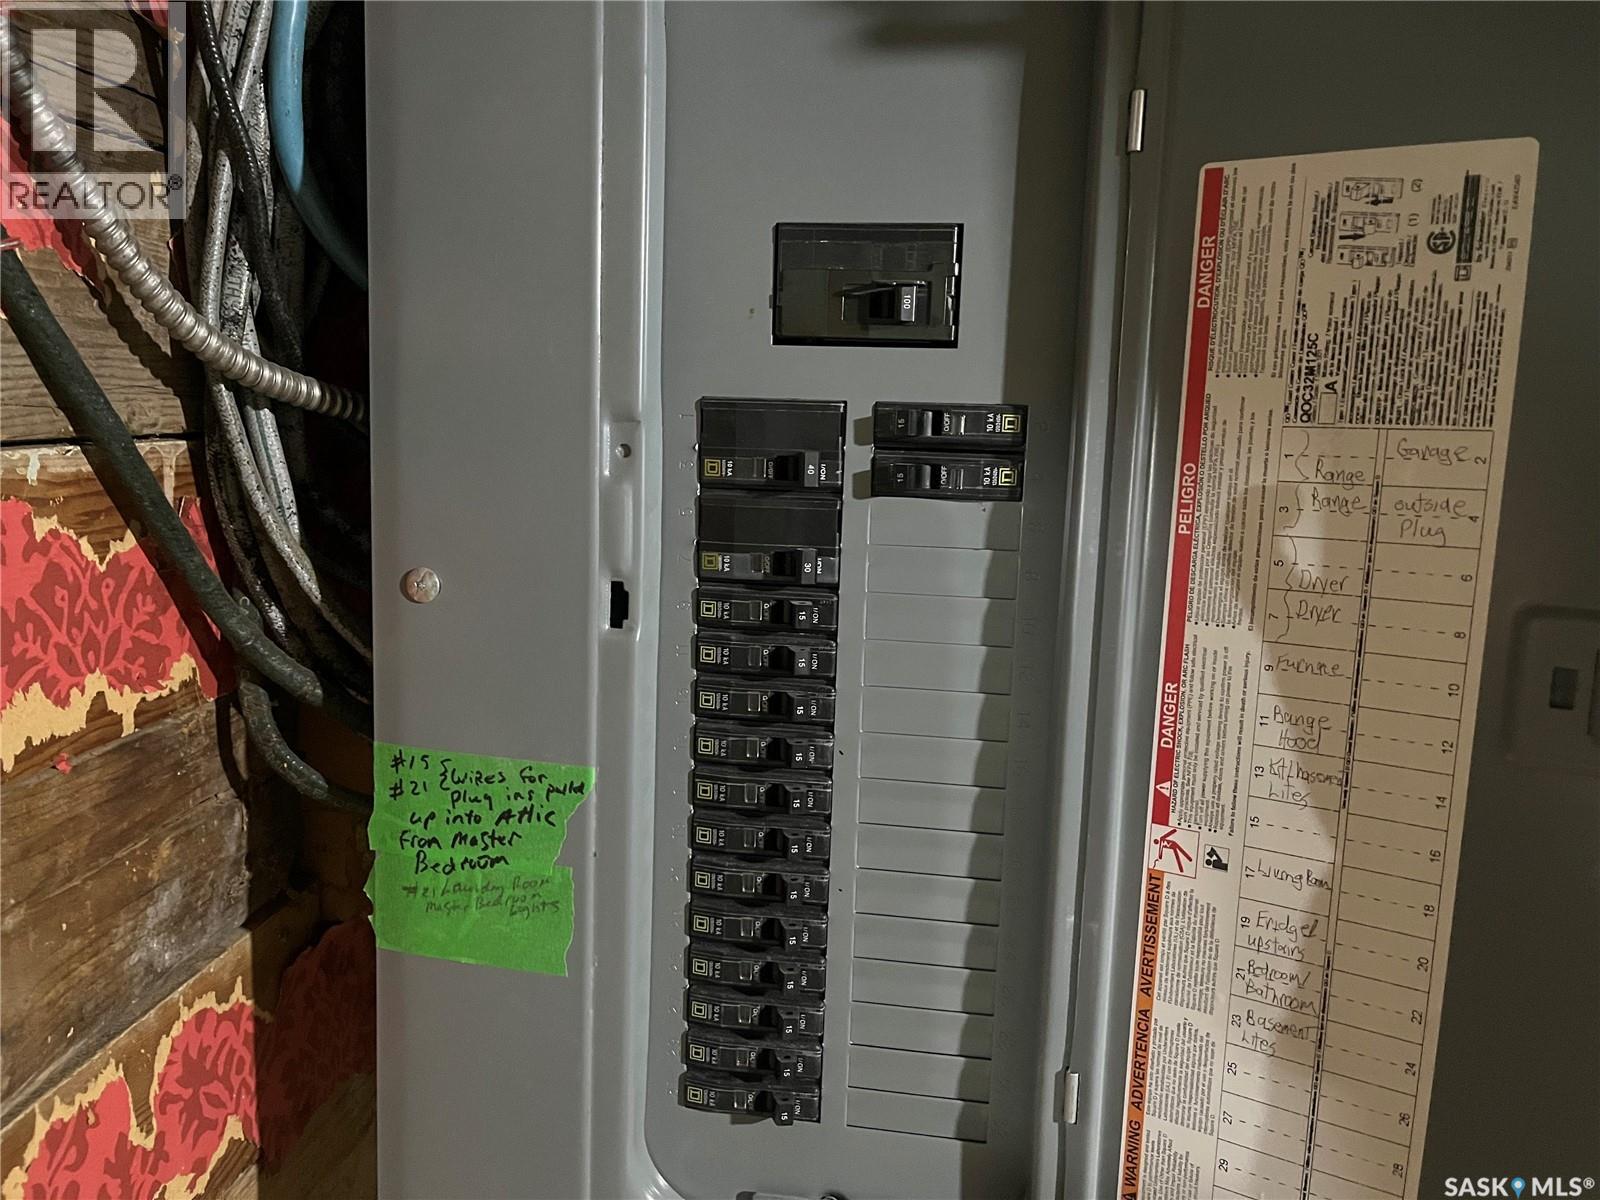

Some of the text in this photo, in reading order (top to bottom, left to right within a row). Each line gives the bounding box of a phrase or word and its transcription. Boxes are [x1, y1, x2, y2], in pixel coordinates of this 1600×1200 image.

[1196, 234, 1217, 309] DANGER
[903, 295, 911, 309] 100
[1324, 380, 1338, 393] A
[898, 419, 904, 428] 15
[986, 413, 994, 432] 10 kA
[1397, 437, 1472, 466] Garage
[727, 468, 732, 476] kA
[808, 465, 814, 474] 40
[983, 467, 991, 485] 10 kA
[1315, 458, 1366, 490] Range
[897, 473, 904, 482] 15
[1178, 462, 1196, 536] PELIGRO
[1279, 505, 1289, 513] 3
[1400, 518, 1447, 546] Plug
[724, 563, 730, 572] kA
[804, 563, 811, 572] 30
[1299, 570, 1349, 598] Dryer
[1461, 574, 1473, 582] 6
[799, 612, 806, 620] 15
[1454, 631, 1466, 639] 8
[798, 659, 805, 667] 15
[1448, 683, 1460, 697] 10
[797, 706, 803, 714] 15
[1160, 682, 1179, 749] DANGER
[1260, 715, 1269, 727] 11
[1442, 740, 1454, 754] 12
[796, 753, 802, 761] 15
[1255, 766, 1264, 778] 13
[793, 800, 800, 808] 15
[1436, 795, 1448, 810] 14
[410, 804, 557, 829] up into Attic
[1250, 816, 1260, 828] 15
[792, 845, 798, 853] 15
[1430, 850, 1441, 863] 16
[1245, 865, 1255, 878] 17
[791, 891, 797, 899] 15
[1425, 904, 1435, 918] 18
[1241, 916, 1250, 928] 19
[789, 937, 796, 945] 15
[1142, 873, 1162, 997] AVERTISSEMENT
[1417, 957, 1430, 972] 20
[1236, 967, 1246, 980] 21
[787, 981, 793, 989] 15
[1231, 1014, 1241, 1028] 23
[1412, 1009, 1424, 1025] 22
[786, 1026, 792, 1034] 15
[1131, 1008, 1150, 1111] ADVERTENCIA
[784, 1069, 790, 1077] 15
[1227, 1062, 1238, 1076] 25
[1405, 1062, 1417, 1077] 24
[1223, 1111, 1233, 1125] 27
[1399, 1112, 1411, 1127] 26
[1123, 1118, 1142, 1188] WARNING
[1219, 1158, 1229, 1173] 29
[1393, 1163, 1404, 1178] 28
